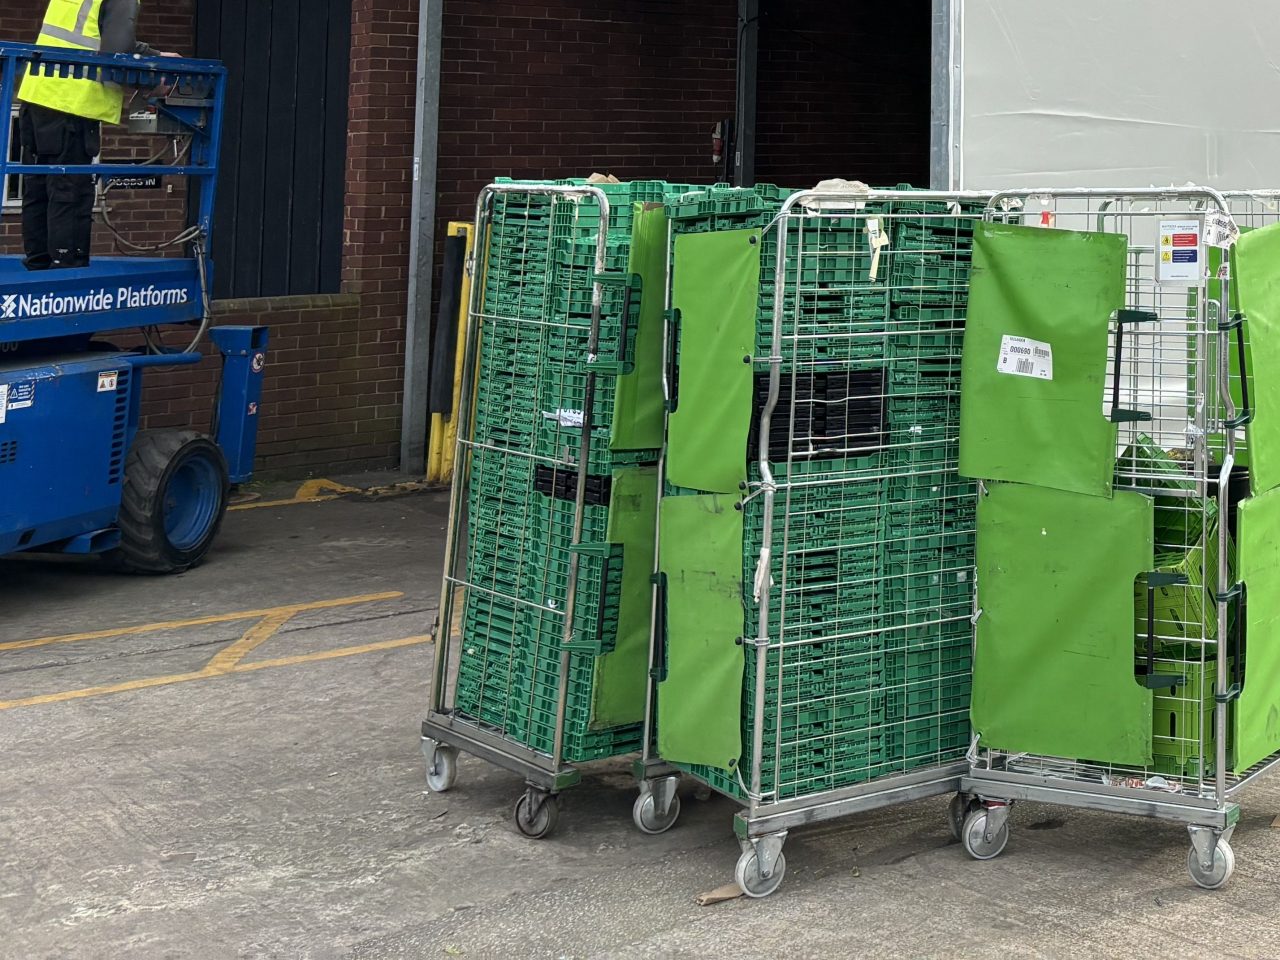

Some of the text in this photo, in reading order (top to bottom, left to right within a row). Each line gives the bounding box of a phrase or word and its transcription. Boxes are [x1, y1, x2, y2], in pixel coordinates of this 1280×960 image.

[145, 177, 156, 186] IN
[18, 284, 188, 317] Nationwide Platforms
